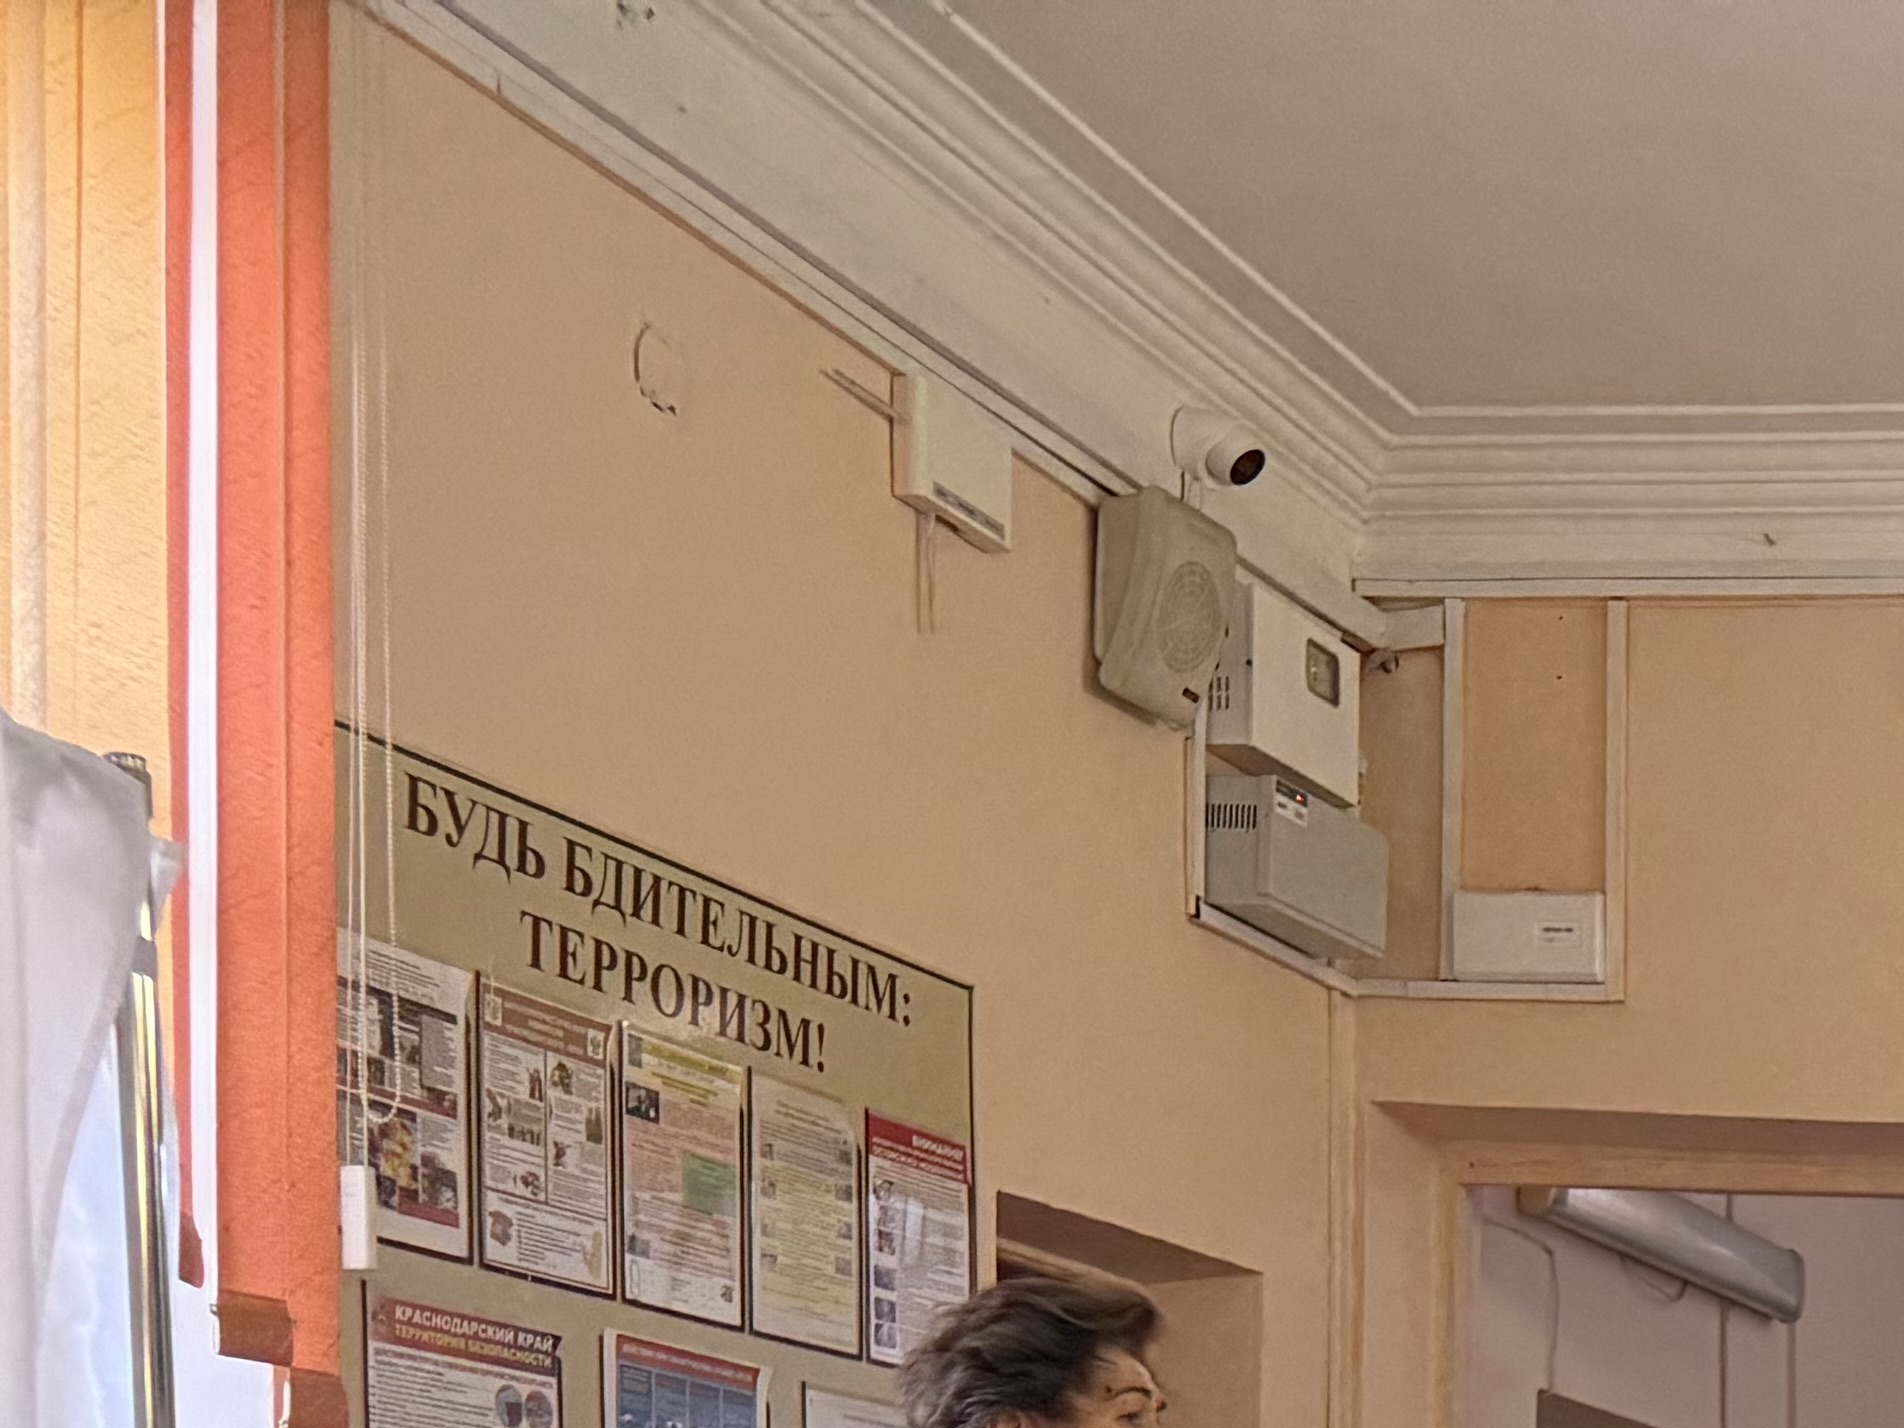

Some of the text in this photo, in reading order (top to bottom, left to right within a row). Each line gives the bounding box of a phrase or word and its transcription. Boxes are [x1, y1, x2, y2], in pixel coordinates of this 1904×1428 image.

[404, 771, 911, 1027] БУДЬ БДИТЕЛЬНЫМ:
[520, 911, 826, 1073] ТЕРРОРИЗМ!
[395, 1305, 553, 1351] КРАСНОДАРСКИЙ КРАЙ
